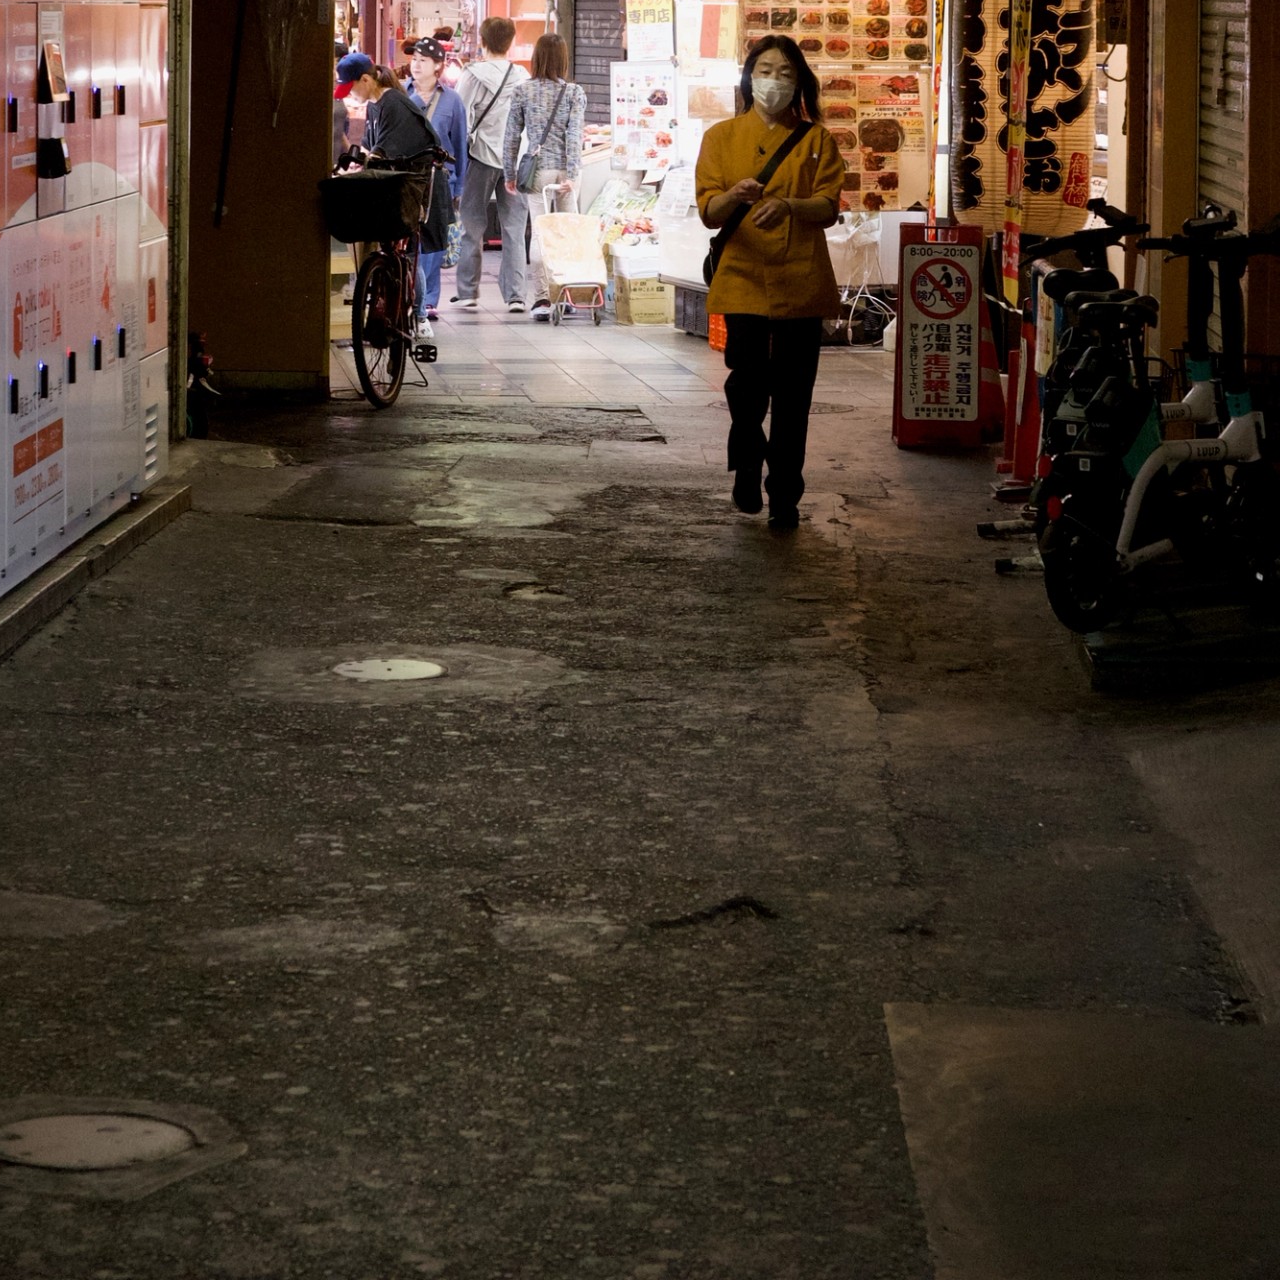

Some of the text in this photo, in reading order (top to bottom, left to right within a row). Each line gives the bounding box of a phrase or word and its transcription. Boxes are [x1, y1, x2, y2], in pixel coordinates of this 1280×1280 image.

[628, 7, 671, 24] 専門店
[1065, 154, 1089, 208] 鶴橋
[922, 323, 935, 353] バイク
[935, 323, 952, 353] 自転車
[922, 354, 951, 405] 走行禁止
[1196, 445, 1221, 457] LUUP
